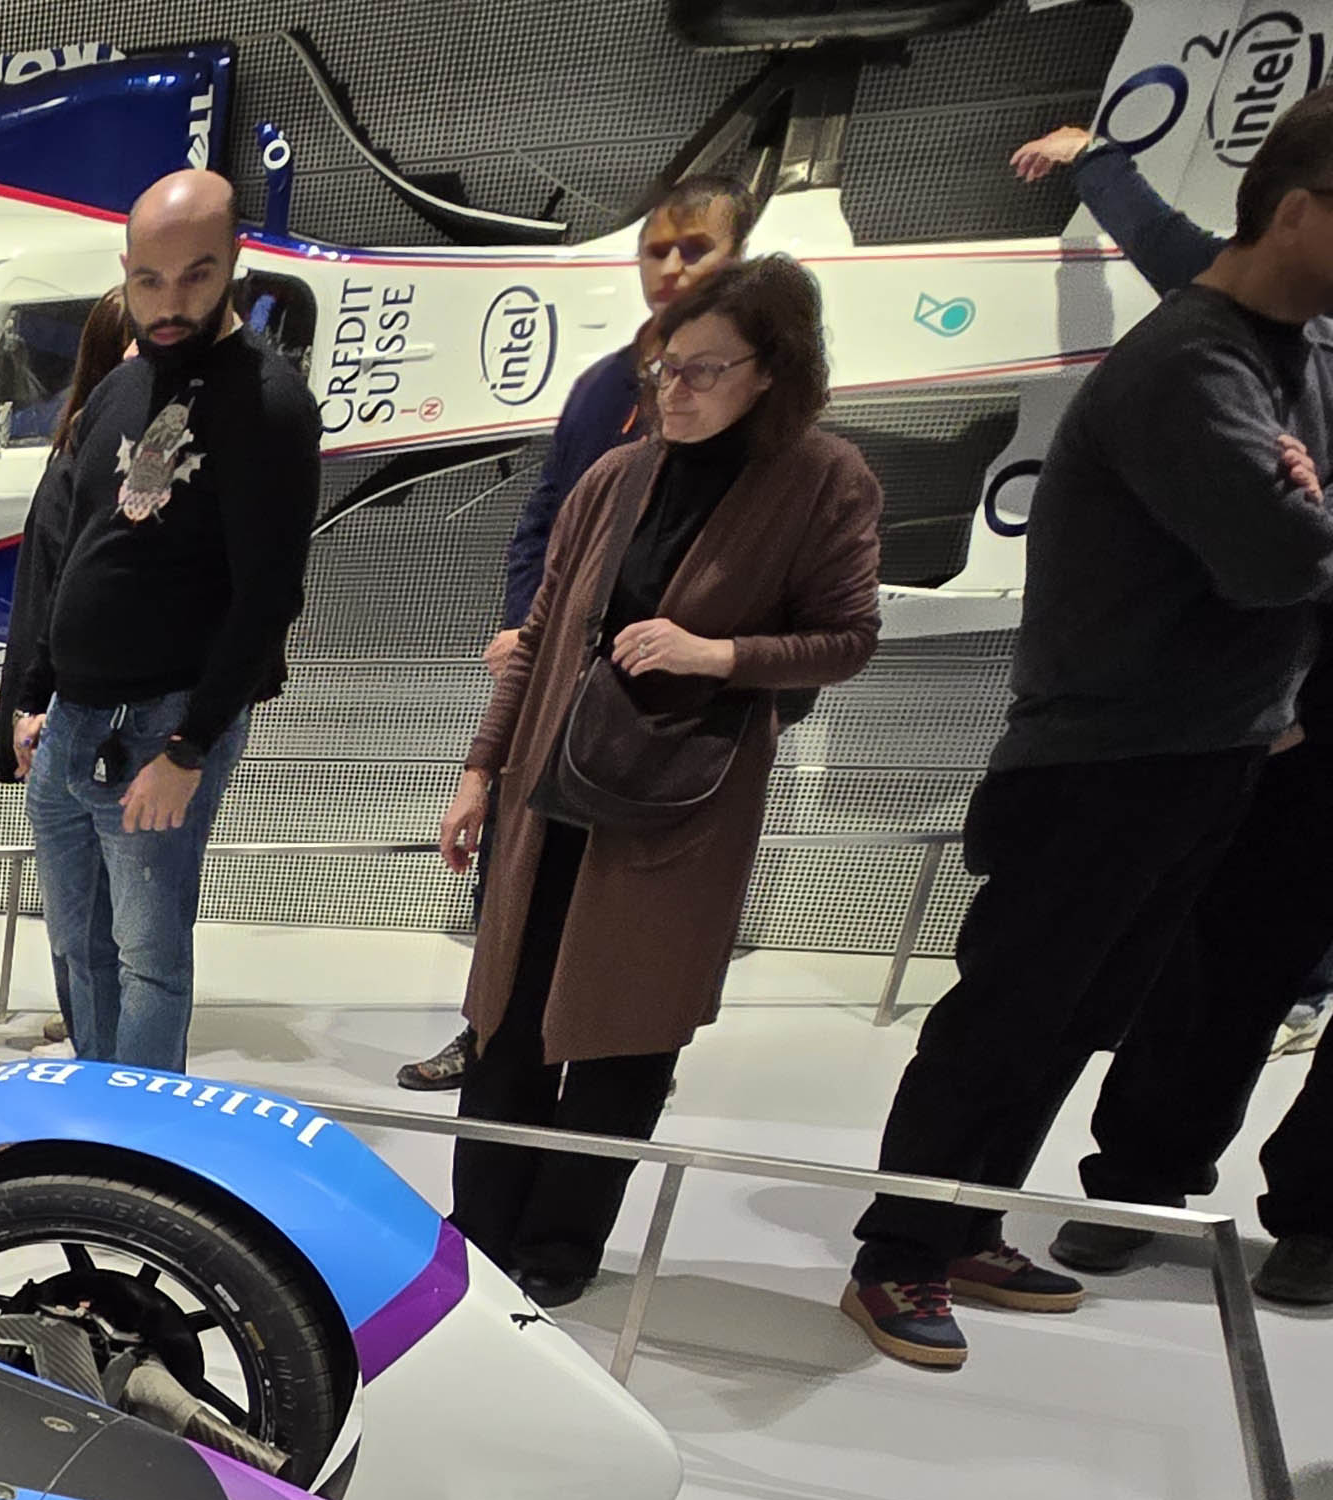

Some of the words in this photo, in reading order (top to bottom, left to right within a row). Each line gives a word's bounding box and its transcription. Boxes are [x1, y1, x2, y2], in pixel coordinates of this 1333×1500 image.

[1213, 37, 1301, 151] intel
[318, 279, 373, 434] CREDIT
[358, 284, 415, 423] SUISSE
[490, 300, 539, 391] intel
[108, 1070, 333, 1148] Julius
